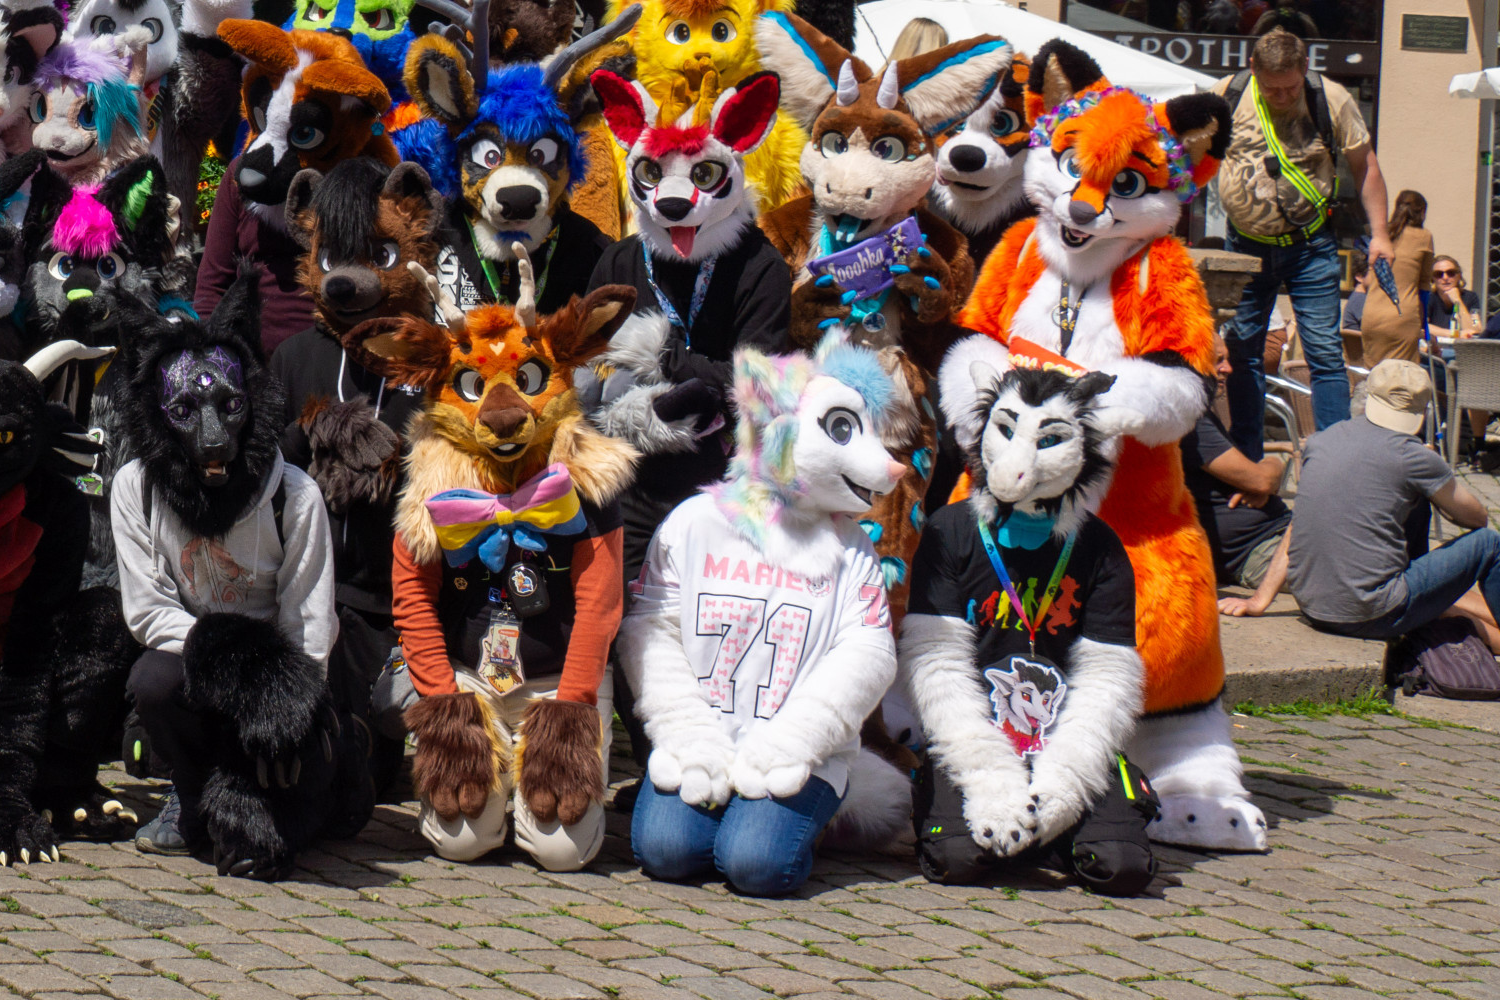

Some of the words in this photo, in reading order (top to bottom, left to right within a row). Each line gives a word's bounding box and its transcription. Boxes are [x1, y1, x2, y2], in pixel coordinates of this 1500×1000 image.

[1115, 34, 1330, 72] POTHE
[703, 552, 804, 592] MARIE
[859, 582, 890, 630] 7
[696, 592, 812, 720] 71
